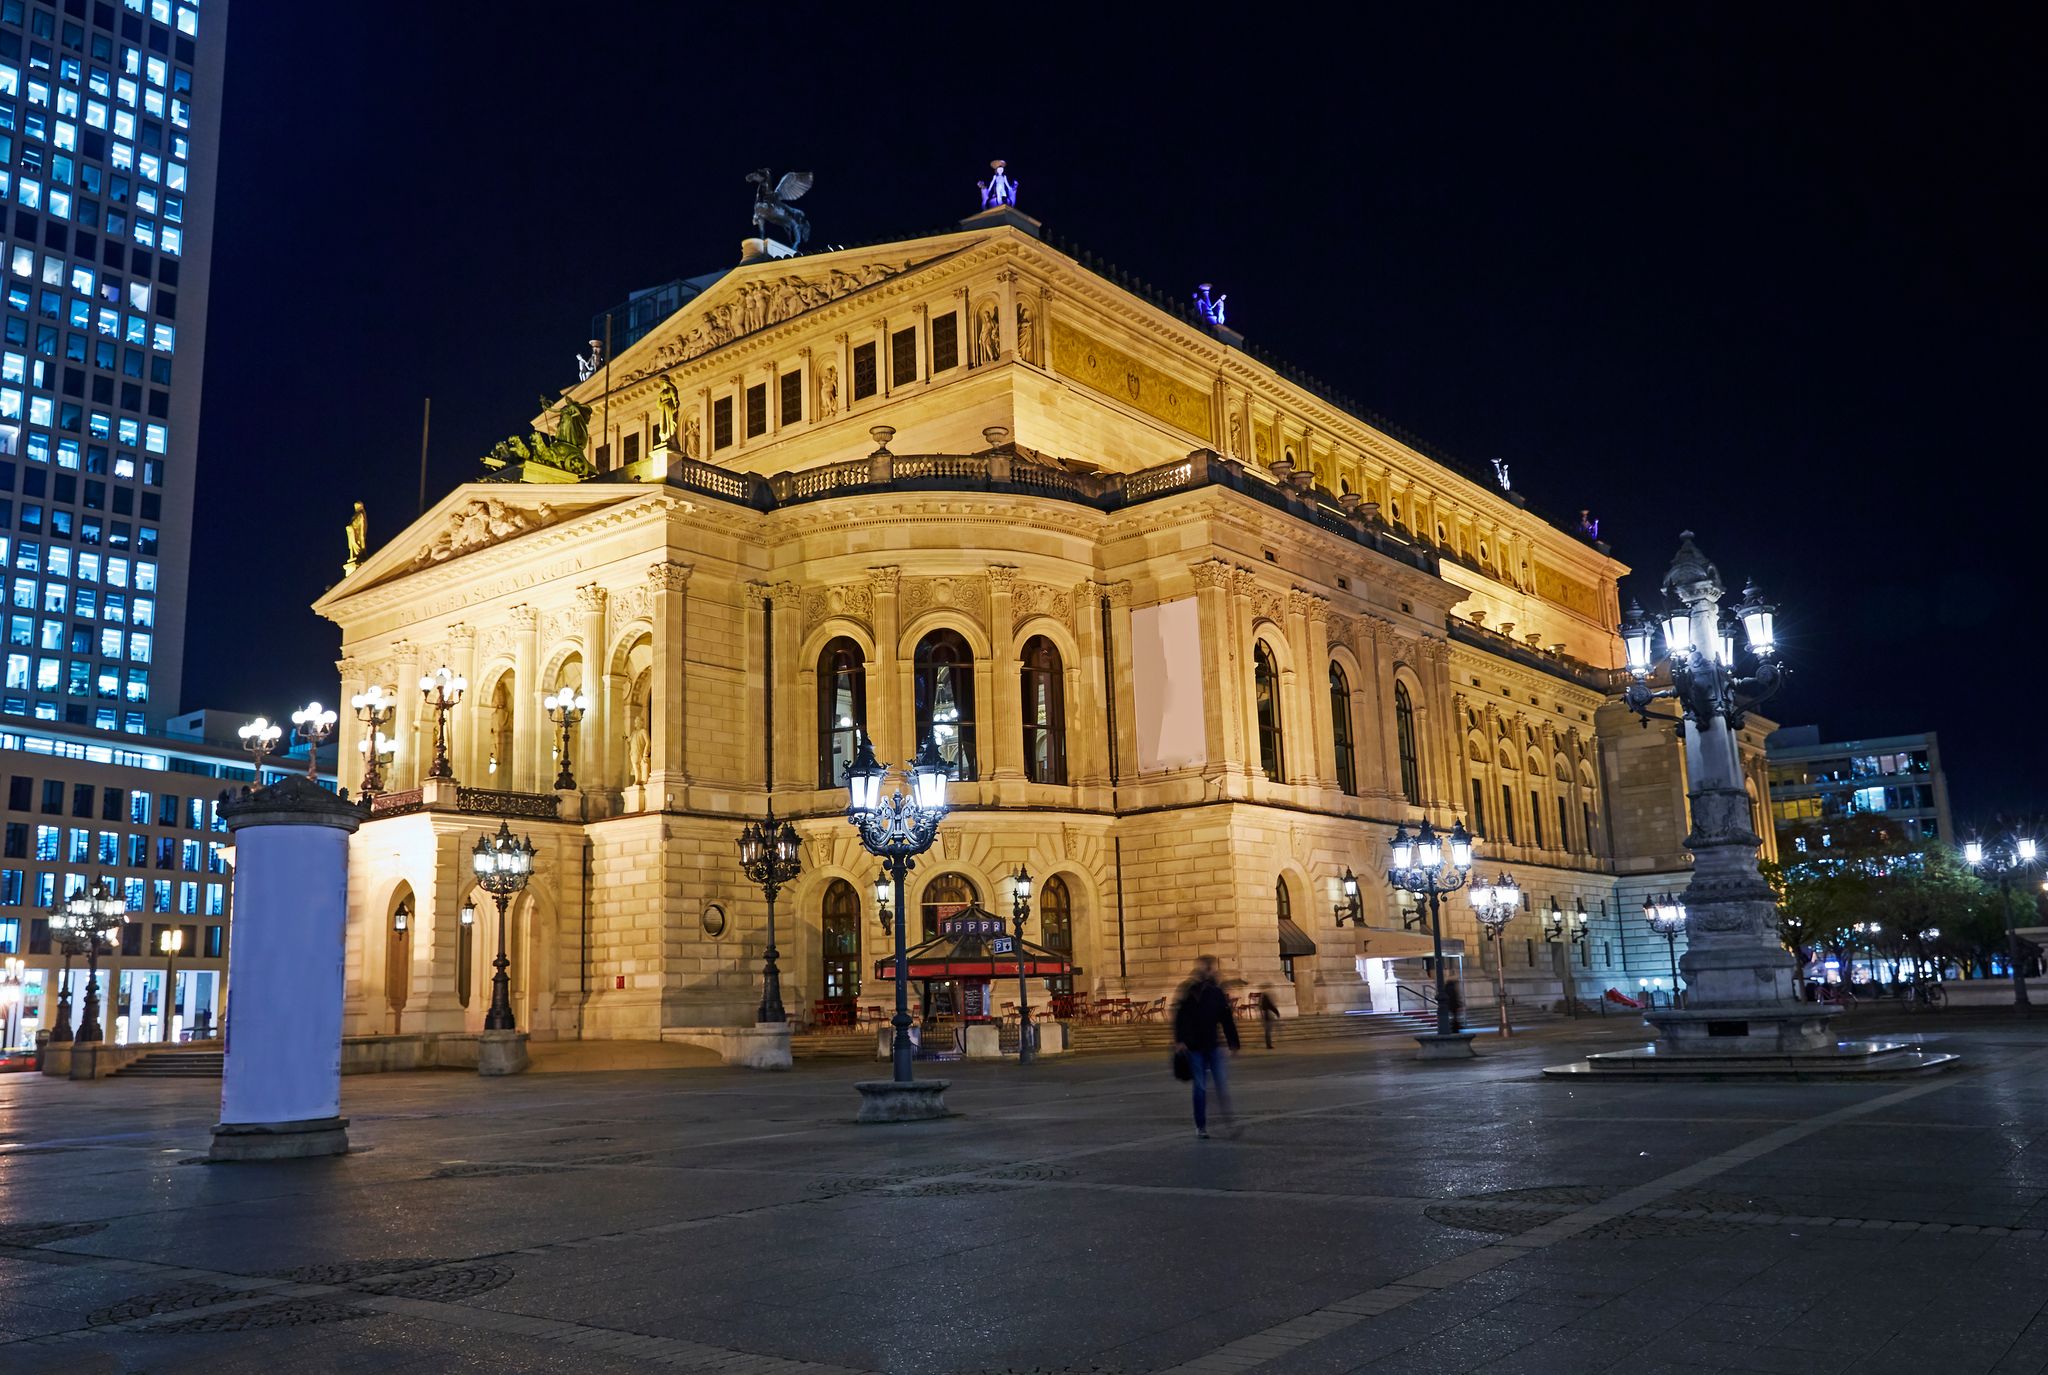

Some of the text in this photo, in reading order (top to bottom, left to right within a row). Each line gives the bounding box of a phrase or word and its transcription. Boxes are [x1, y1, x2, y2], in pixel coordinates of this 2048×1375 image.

[423, 591, 469, 617] WAHREN
[473, 571, 537, 603] SCHOENEN
[541, 554, 584, 582] GUTEN
